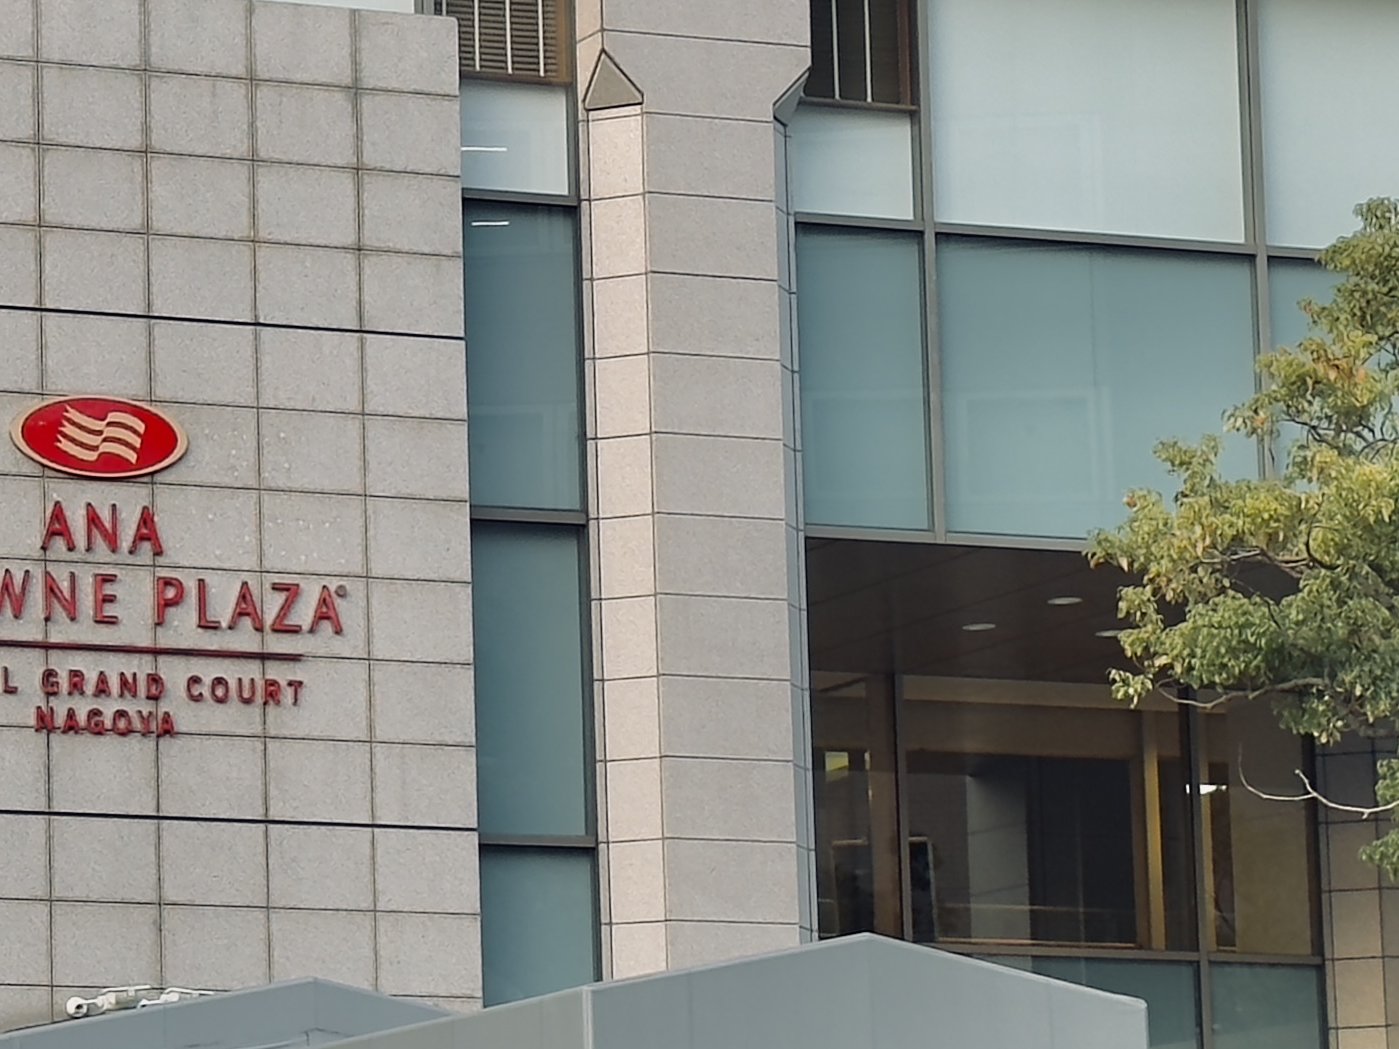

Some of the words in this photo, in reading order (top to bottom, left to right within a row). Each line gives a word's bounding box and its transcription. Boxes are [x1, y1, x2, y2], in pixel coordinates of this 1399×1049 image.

[41, 500, 163, 556] ANA
[154, 576, 343, 634] PLAZA
[41, 668, 165, 700] GRAND
[186, 675, 304, 706] COURT
[34, 705, 177, 738] NAGOYA
